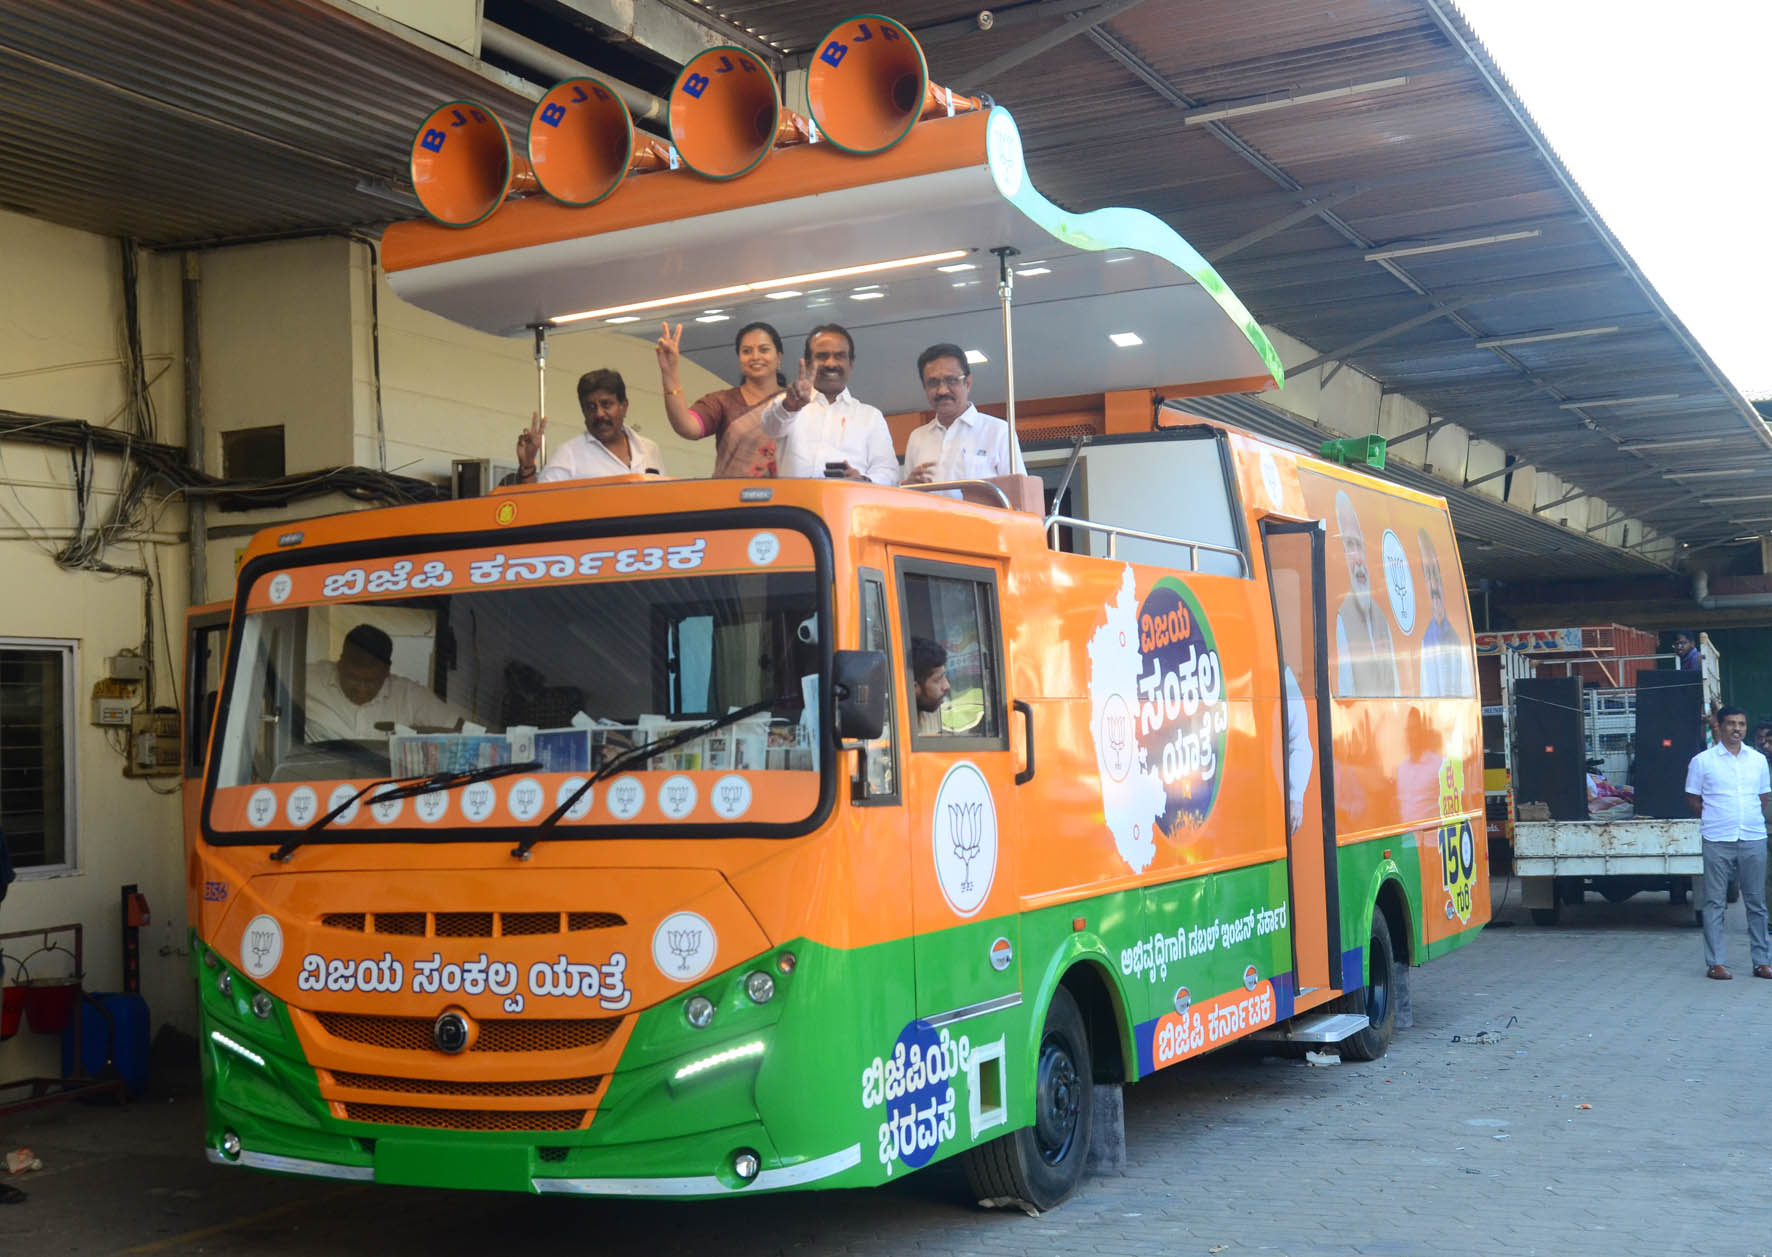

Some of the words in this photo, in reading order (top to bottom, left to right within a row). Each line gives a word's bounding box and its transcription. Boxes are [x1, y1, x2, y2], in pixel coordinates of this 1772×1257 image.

[820, 24, 899, 68] BJP
[322, 560, 452, 598] ಬಿಜೆಪಿ
[469, 539, 707, 586] ಕರ್ನಾಟಕ
[1141, 601, 1191, 653] ವಿಜಯ
[1139, 644, 1228, 736] ಸಂಕಲ್ಪ
[1162, 711, 1217, 784] ಯಾತ್ರೆ
[1439, 821, 1473, 886] 150
[1188, 918, 1220, 957] ಡಬಲ್
[1256, 900, 1287, 937] ಸರ್ಕಾರ
[298, 952, 402, 993] ವಿಜಯ
[411, 953, 526, 1013] ಸಂಕಲ್ಪ
[528, 951, 632, 1011] ಯಾತ್ರೆ
[1158, 1011, 1204, 1062] ಬಿಜೆಪಿ
[1208, 986, 1271, 1041] ಕರ್ನಾಟಕ
[862, 1028, 970, 1109] ಬಿಜೆಪಿಯೇ
[878, 1087, 956, 1176] ಭರವಸೆ
